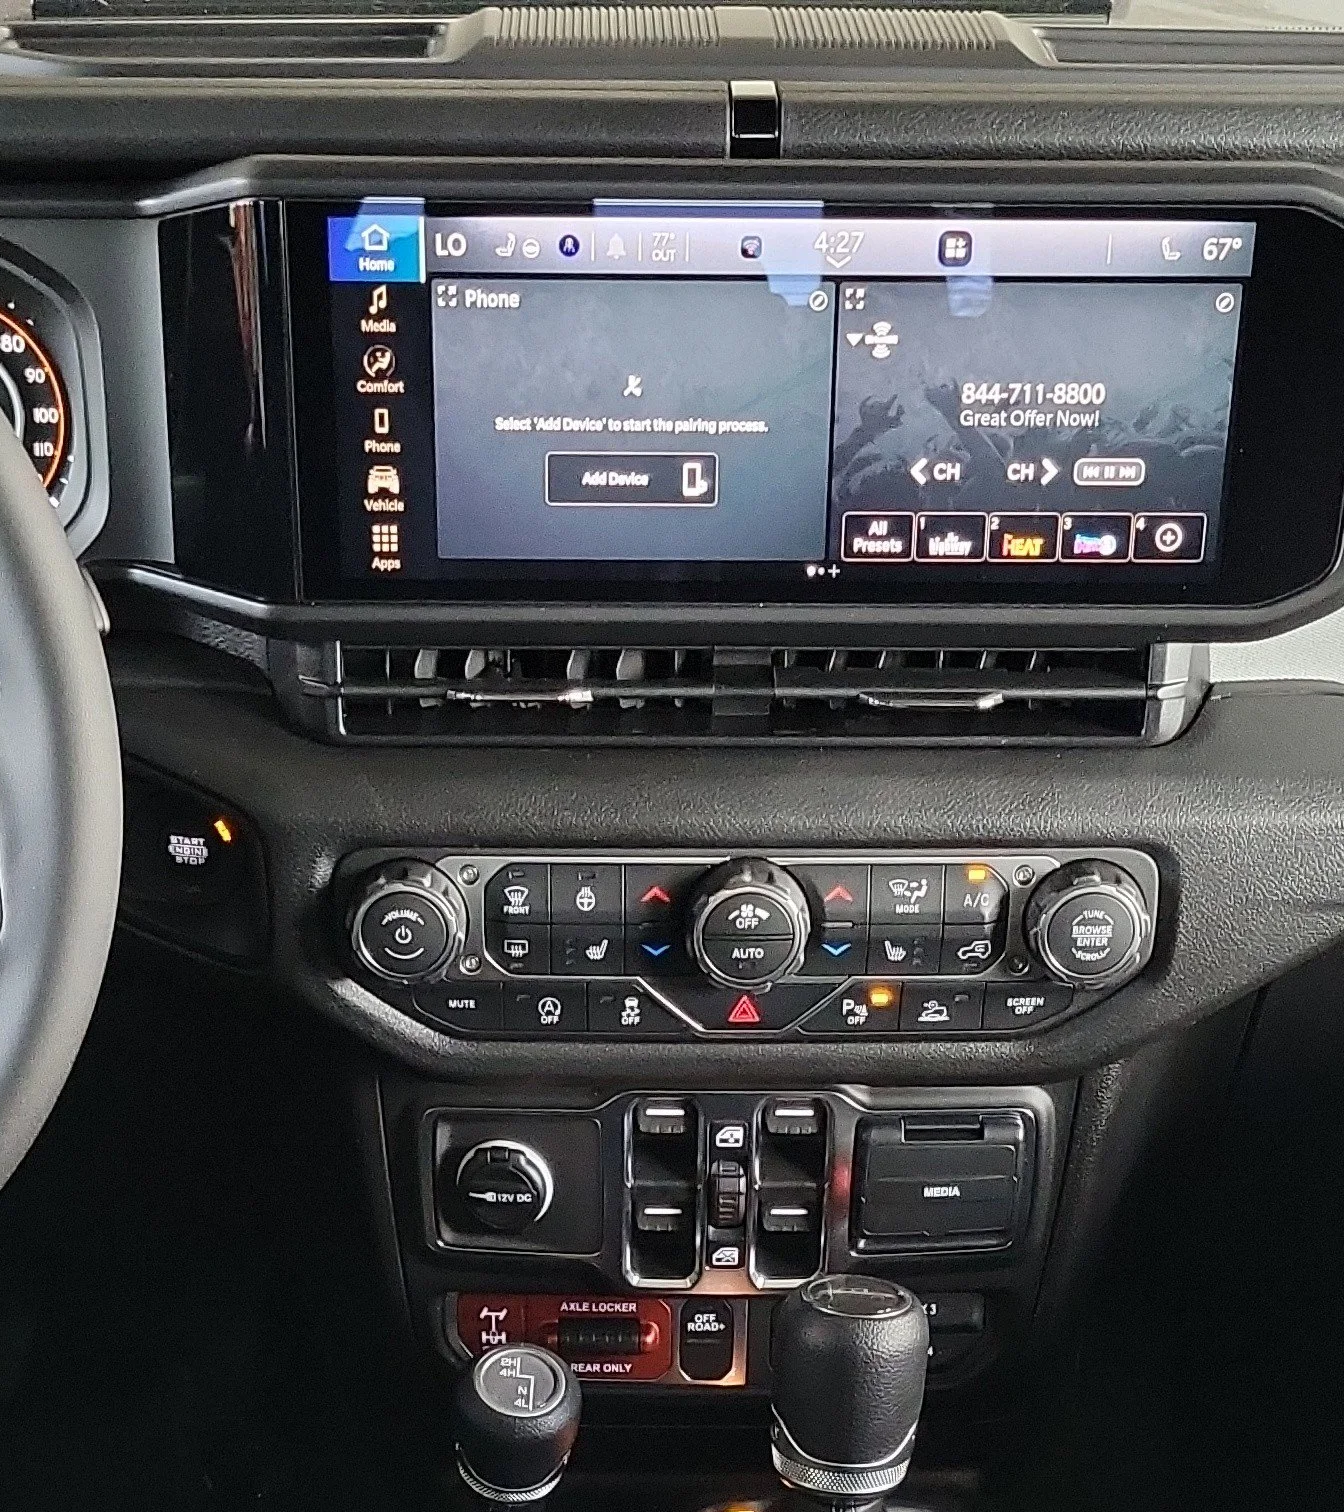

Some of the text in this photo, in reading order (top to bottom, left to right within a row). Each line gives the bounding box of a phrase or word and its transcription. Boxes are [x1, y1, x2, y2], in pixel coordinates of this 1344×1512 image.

[434, 232, 467, 257] LO
[814, 230, 865, 253] 4:27
[651, 249, 677, 262] OUT
[1202, 237, 1243, 262] 67°
[358, 257, 395, 272] Home
[464, 287, 521, 309] Phone
[360, 318, 397, 333] Media
[0, 334, 26, 354] 80
[24, 368, 46, 384] 90
[356, 379, 405, 394] Comfort
[960, 382, 1106, 405] 844-711-8800
[32, 407, 59, 424] 100
[959, 410, 1100, 427] Great Offer Now!
[494, 417, 532, 432] Select
[607, 418, 621, 432] to
[622, 418, 651, 432] start
[654, 418, 673, 432] the
[674, 418, 716, 435] pairing
[718, 420, 769, 435] process.
[32, 441, 55, 457] 110
[364, 440, 402, 454] Phone
[932, 463, 961, 482] CH
[1006, 463, 1035, 482] CH
[581, 472, 649, 487] Add Device
[363, 498, 405, 512] Vehicle
[868, 521, 888, 536] All
[919, 516, 926, 531] 1
[990, 517, 1000, 530] 2
[1063, 517, 1073, 530] 3
[1136, 517, 1147, 531] 4
[853, 538, 903, 554] Presets
[371, 556, 402, 572] Apps
[169, 834, 205, 846] START
[175, 856, 205, 866] STOP
[963, 892, 990, 908] A/C
[384, 909, 419, 922] VOLUME
[503, 905, 530, 916] FRONT
[895, 904, 921, 915] MODE
[1083, 909, 1106, 920] TUNE
[735, 917, 760, 930] OFF
[1072, 925, 1113, 935] BROWSE
[1076, 937, 1108, 947] ENTER
[731, 947, 765, 960] AUTO
[448, 998, 476, 1010] MUTE
[1006, 997, 1044, 1008] SCREEN
[1014, 1005, 1034, 1016] OFF
[540, 1014, 560, 1026] OFF
[620, 1015, 641, 1027] OFF
[847, 1016, 867, 1027] OFF
[497, 1193, 532, 1204] 12V DC
[923, 1186, 961, 1199] MEDIA
[560, 1302, 637, 1314] AXLE LOCKER
[694, 1313, 716, 1325] OFF
[499, 1368, 516, 1378] 4H
[571, 1362, 632, 1374] REAR ONLY
[518, 1386, 528, 1396] N
[514, 1398, 528, 1408] 4L
